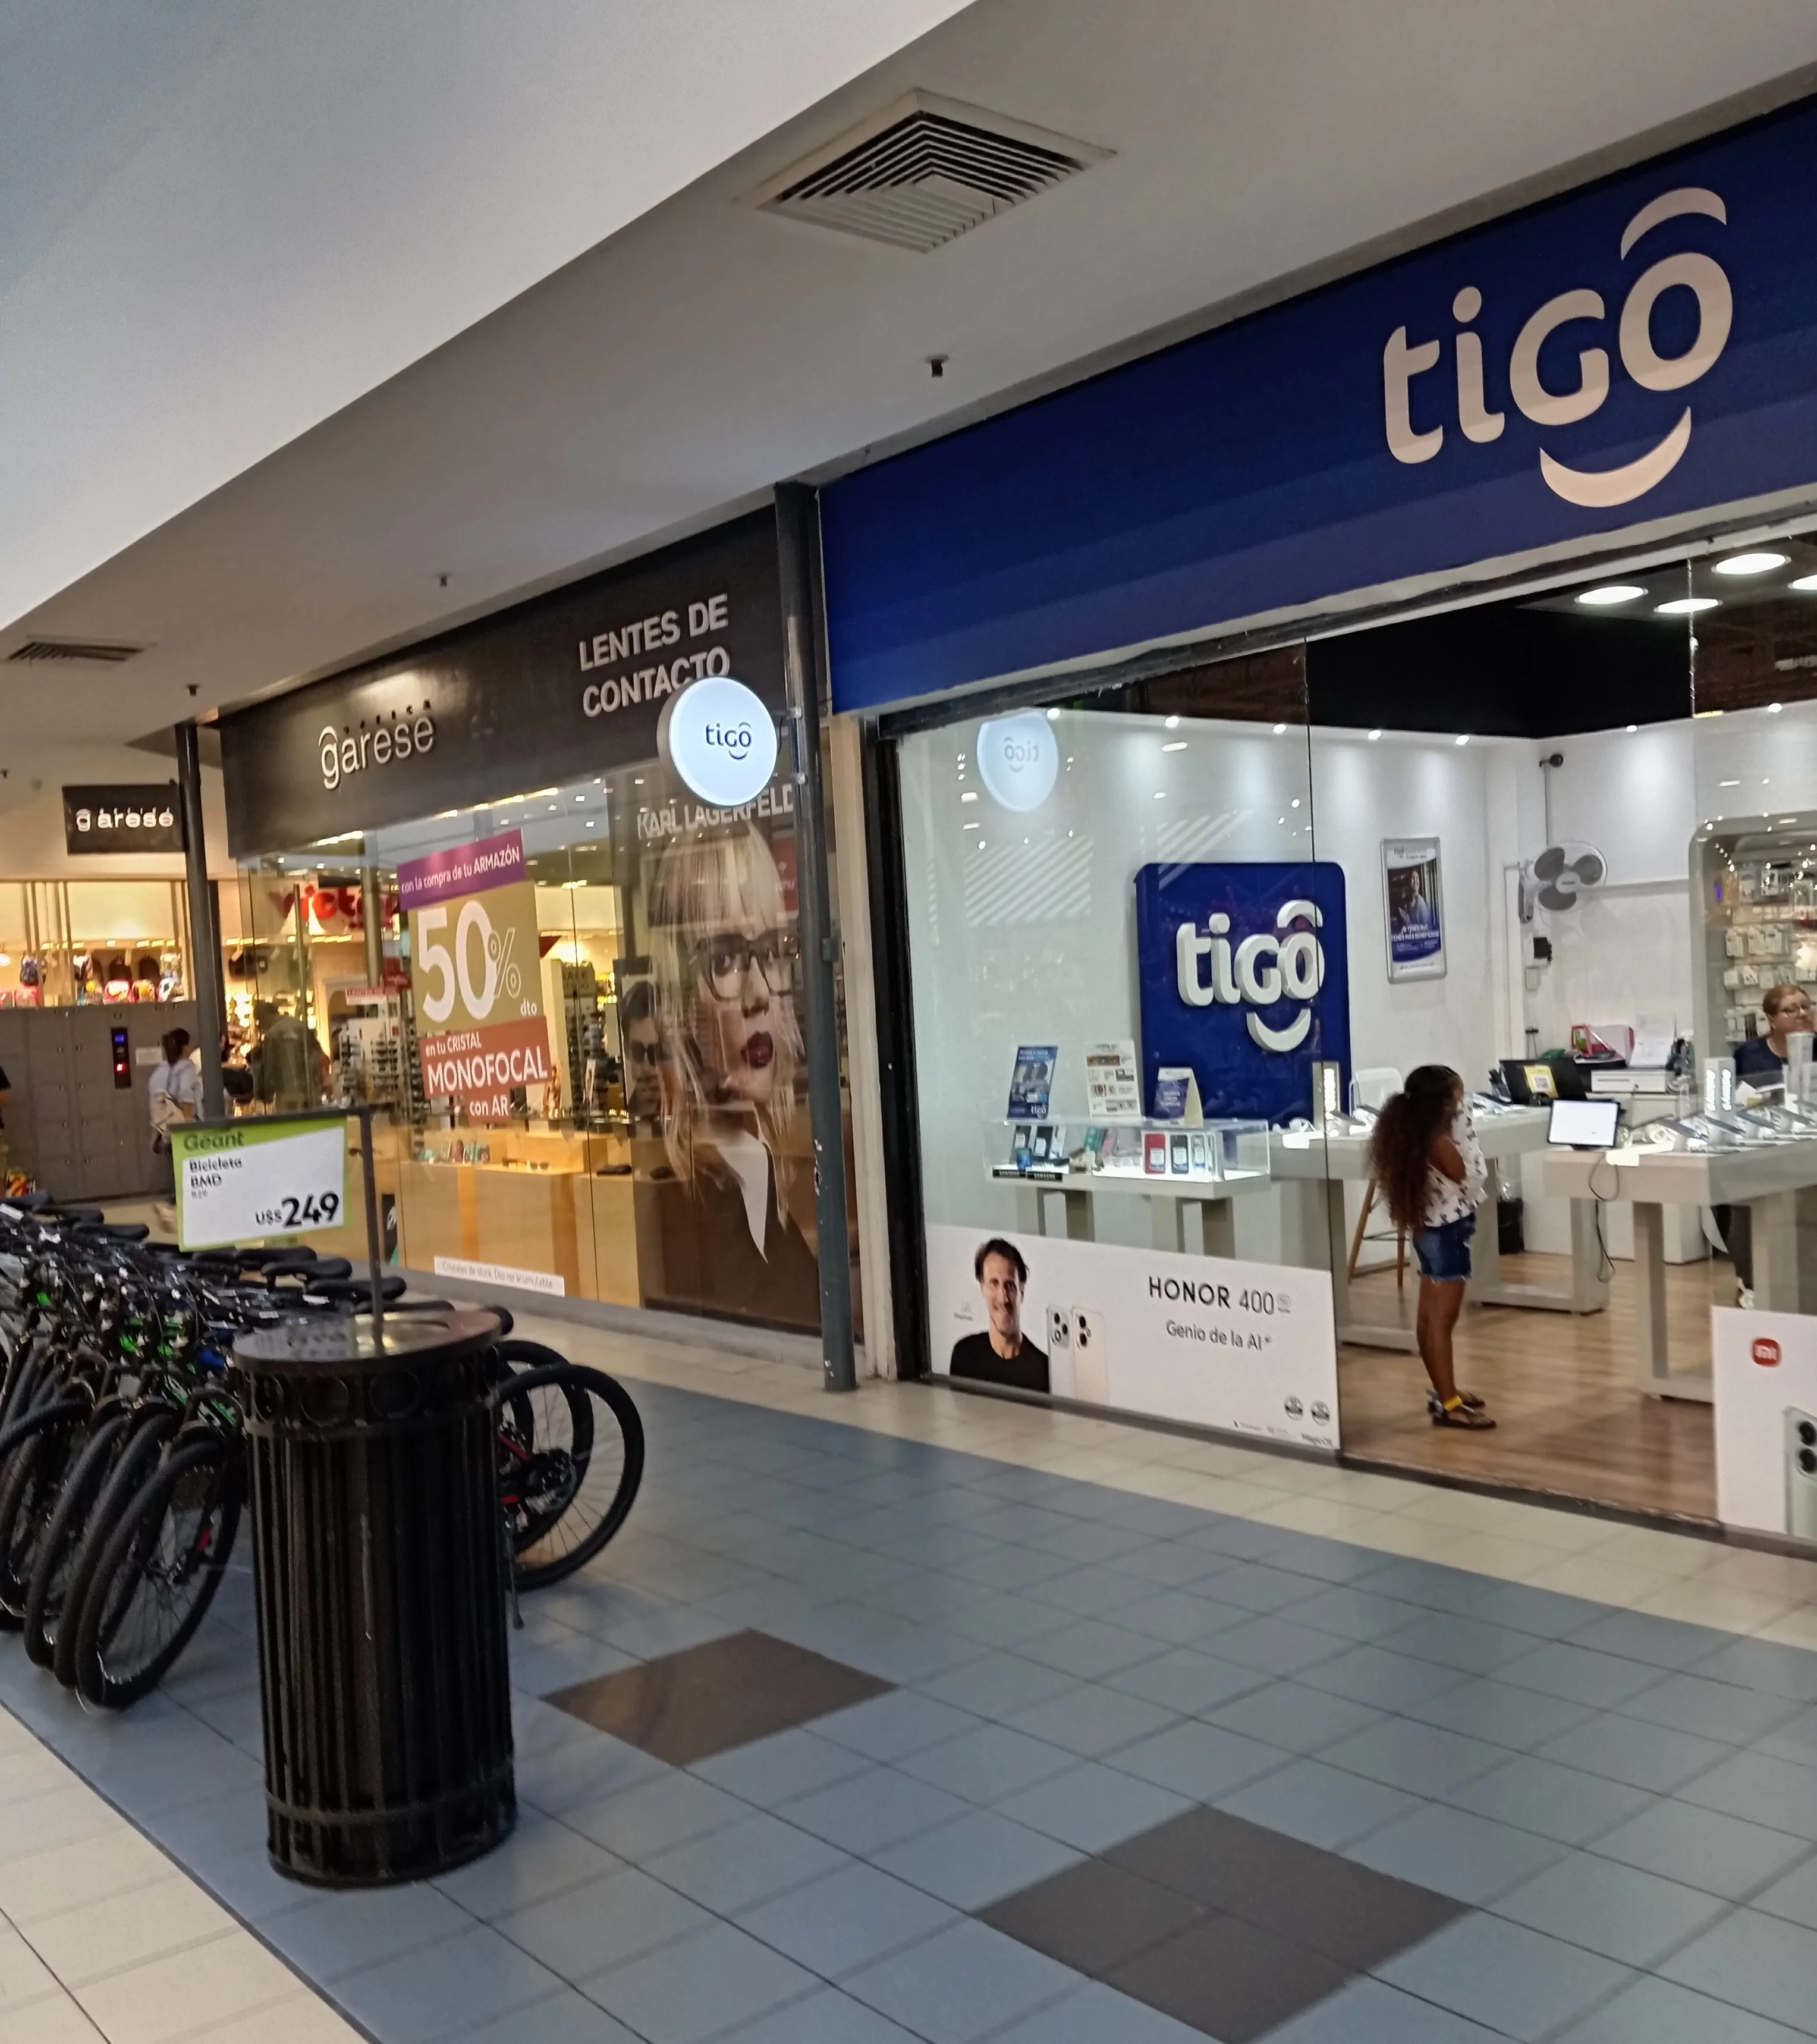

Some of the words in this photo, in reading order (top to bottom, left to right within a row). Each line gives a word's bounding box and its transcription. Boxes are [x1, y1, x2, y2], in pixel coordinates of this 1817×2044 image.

[579, 610, 681, 671] LENTES
[688, 594, 729, 637] DE
[583, 646, 730, 717] CONTACTO
[318, 726, 434, 790] garese
[637, 806, 683, 840] KARL
[401, 880, 414, 894] con
[415, 875, 423, 891] la
[423, 870, 451, 888] compra
[452, 865, 463, 881] de
[464, 863, 472, 877] tu
[473, 844, 520, 875] ARMAZÓN
[417, 900, 521, 1022] 50%
[520, 999, 537, 1016] dto
[426, 1044, 436, 1057] en
[437, 1041, 446, 1055] tu
[447, 1031, 482, 1054] CRISTAL
[427, 1045, 548, 1095] MONOFOCAL
[470, 1100, 489, 1116] con
[492, 1095, 509, 1116] AR
[281, 1190, 339, 1228] 249
[1149, 1275, 1231, 1310] HONOR
[1238, 1289, 1274, 1315] 400
[1166, 1318, 1206, 1342] Genio
[1209, 1326, 1227, 1345] de
[1230, 1329, 1243, 1348] la
